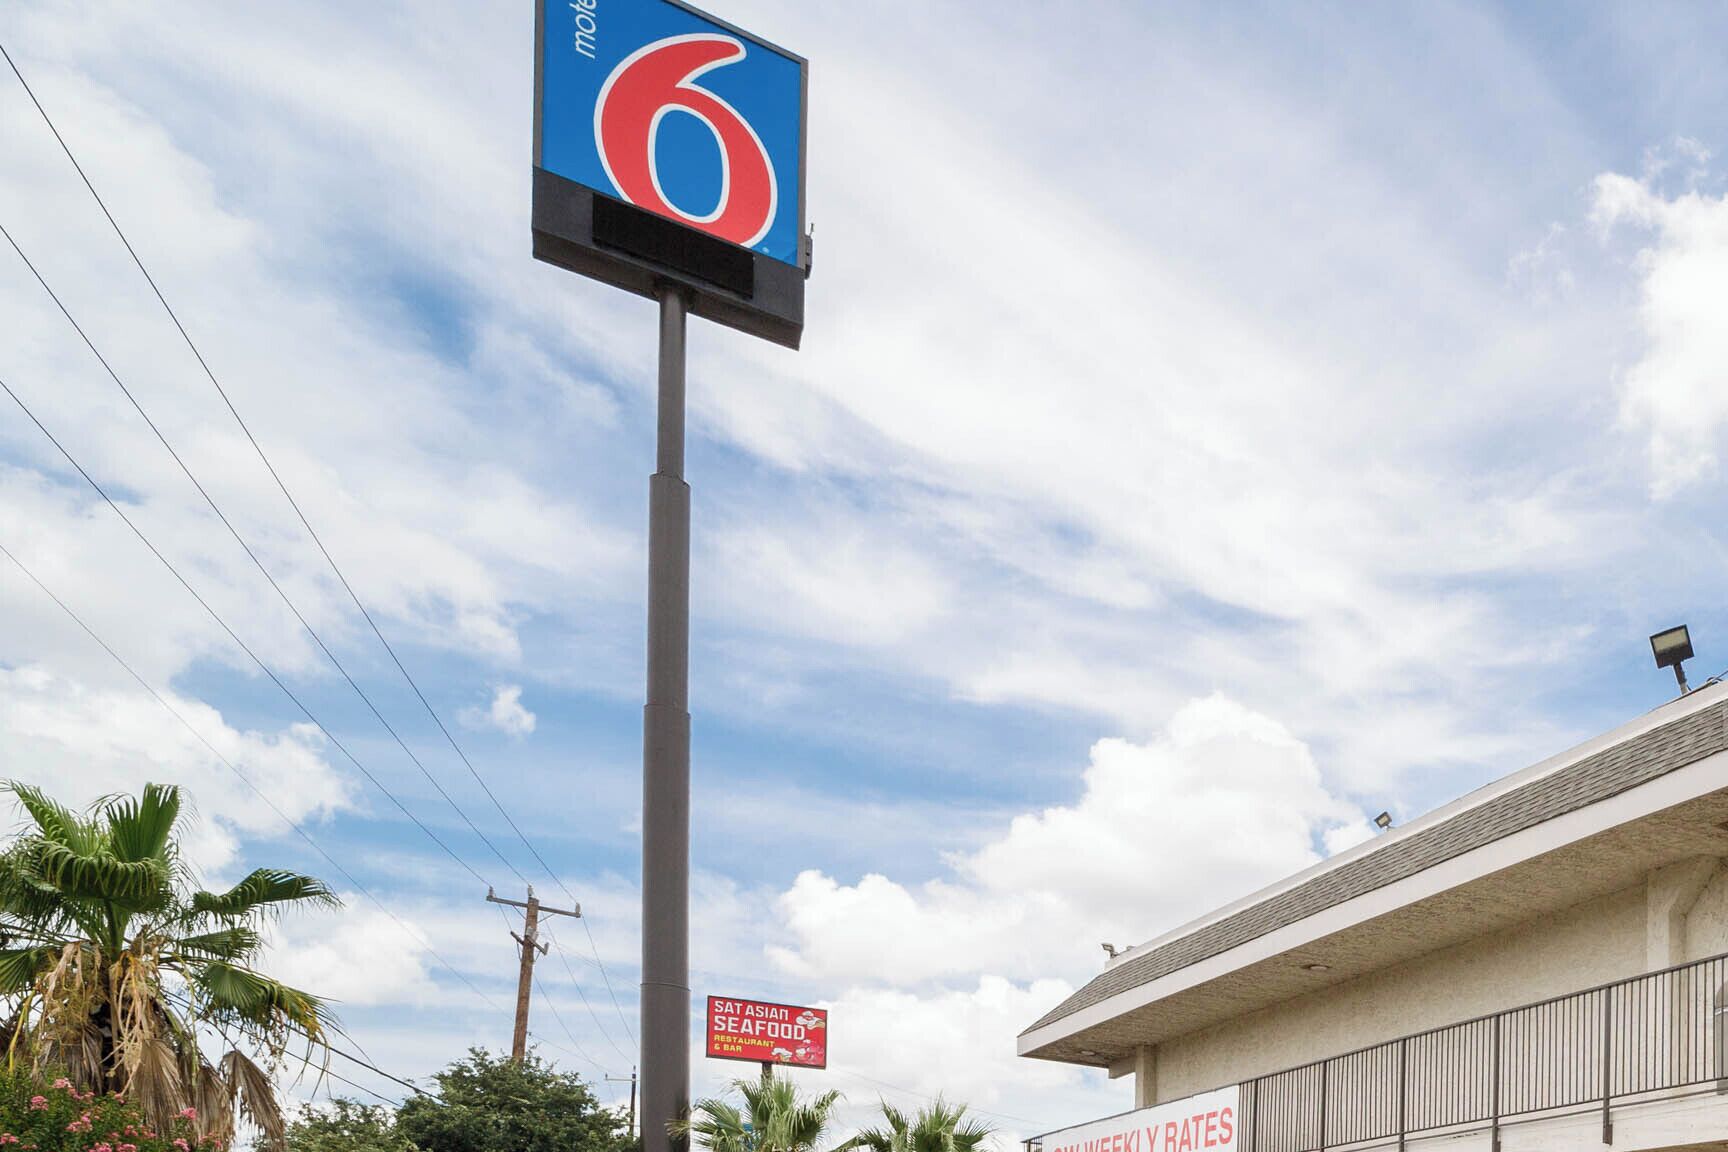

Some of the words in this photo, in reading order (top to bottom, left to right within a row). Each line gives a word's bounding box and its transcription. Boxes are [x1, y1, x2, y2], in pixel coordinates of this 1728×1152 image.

[593, 33, 778, 248] 6
[714, 1001, 742, 1015] SAT
[745, 1004, 788, 1021] ASIAN
[714, 1015, 805, 1041] SEAFOOD
[714, 1034, 775, 1048] RESTAURANT
[723, 1044, 742, 1052] BAR
